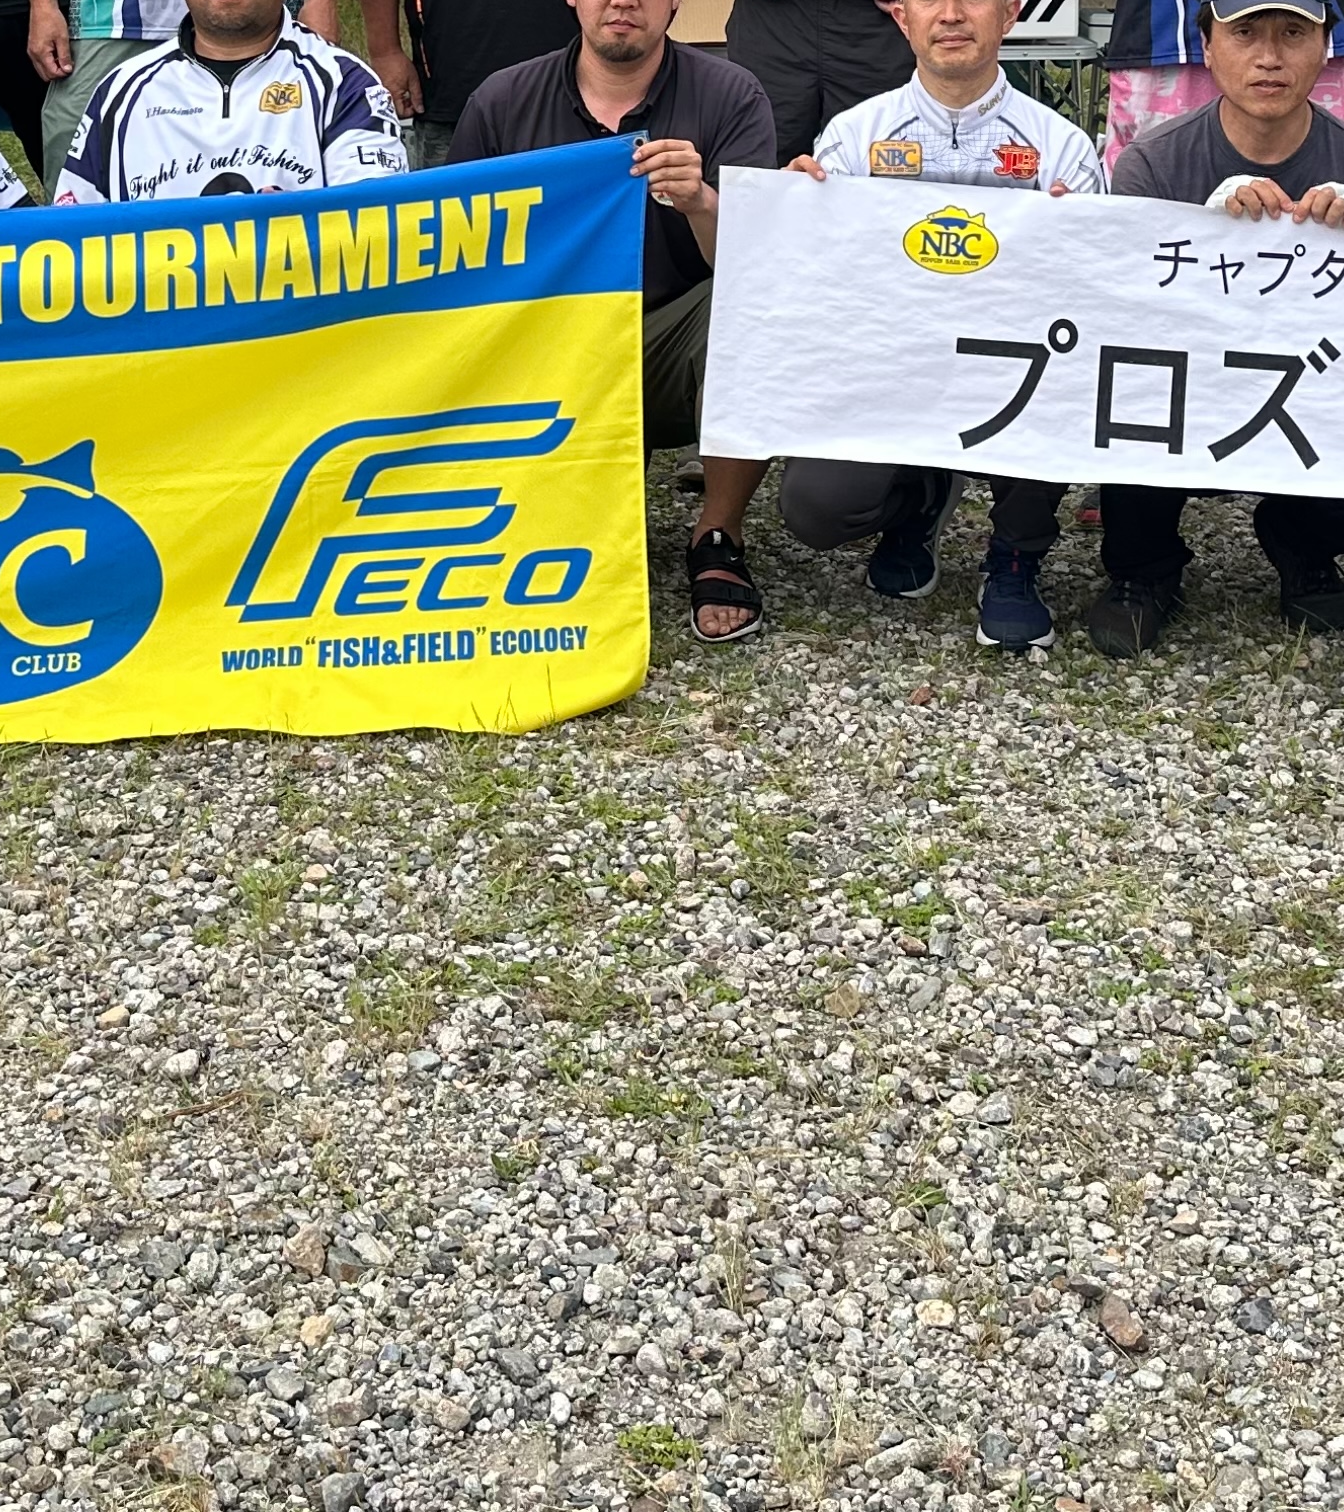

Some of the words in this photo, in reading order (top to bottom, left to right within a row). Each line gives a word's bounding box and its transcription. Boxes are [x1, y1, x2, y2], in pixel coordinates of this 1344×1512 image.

[266, 90, 295, 105] NBC
[875, 149, 917, 167] NBC
[129, 159, 180, 200] Fight
[186, 152, 205, 173] it
[210, 147, 245, 169] out!
[249, 145, 318, 181] Fishing
[919, 229, 982, 260] NBC
[221, 644, 303, 673] WORLD
[490, 626, 589, 656] ECOLOGY
[11, 652, 82, 676] CLUB
